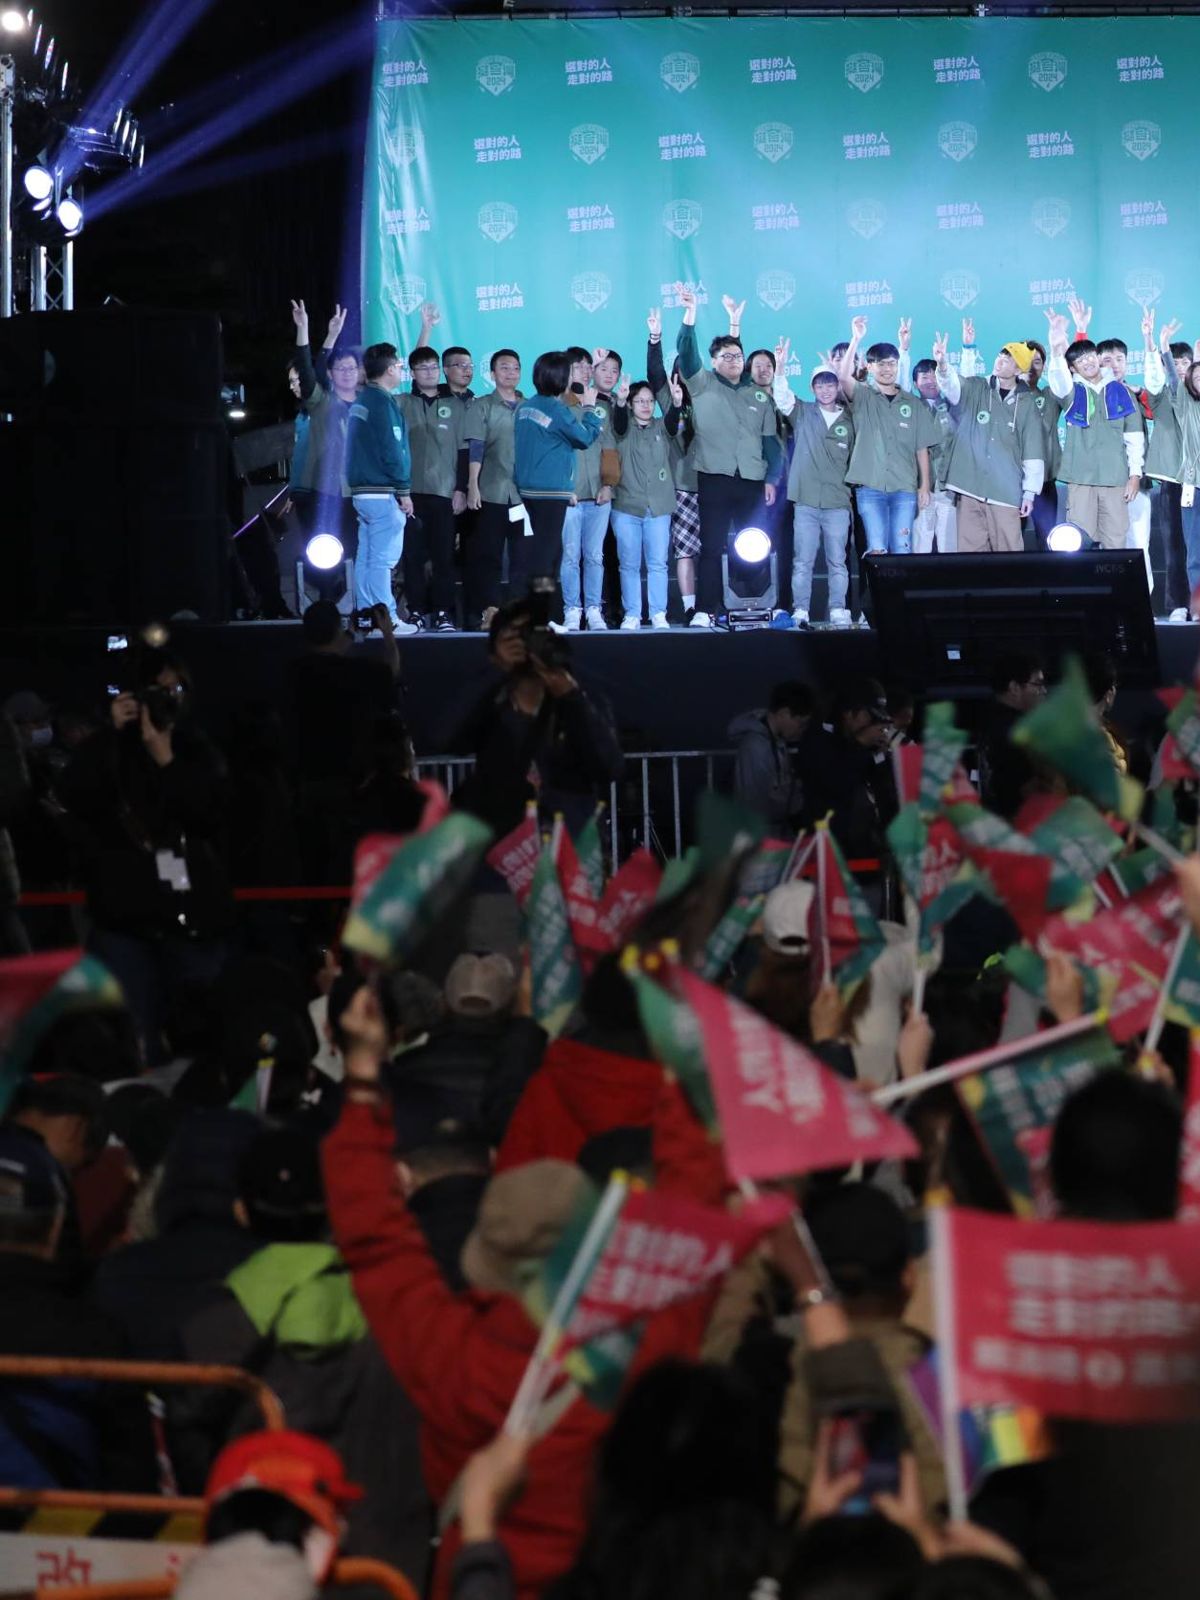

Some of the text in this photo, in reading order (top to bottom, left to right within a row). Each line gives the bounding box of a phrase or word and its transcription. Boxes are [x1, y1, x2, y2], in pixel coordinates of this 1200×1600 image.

[383, 58, 427, 74] 選對的人
[565, 58, 610, 73] 選對的人
[749, 56, 795, 71] 選對的人
[933, 56, 978, 71] 選對的人
[1117, 55, 1161, 69] 選對的人
[382, 72, 430, 87] 走對的路
[567, 70, 613, 86] 走對的路
[752, 69, 797, 83] 走對的路
[936, 68, 981, 83] 走對的路
[1120, 67, 1164, 82] 走對的路
[474, 135, 519, 151] 選對的人
[658, 133, 703, 148] 選對的人
[843, 132, 888, 146] 選對的人
[1026, 131, 1072, 145] 選對的人
[476, 147, 522, 163] 走對的路
[660, 144, 706, 160] 走對的路
[845, 144, 891, 159] 走對的路
[1029, 143, 1074, 158] 走對的路
[476, 282, 522, 299] 選對的人
[845, 280, 891, 296] 選對的人
[1030, 278, 1075, 292] 選對的人
[478, 295, 524, 312] 走對的路
[847, 292, 895, 308] 走對的路
